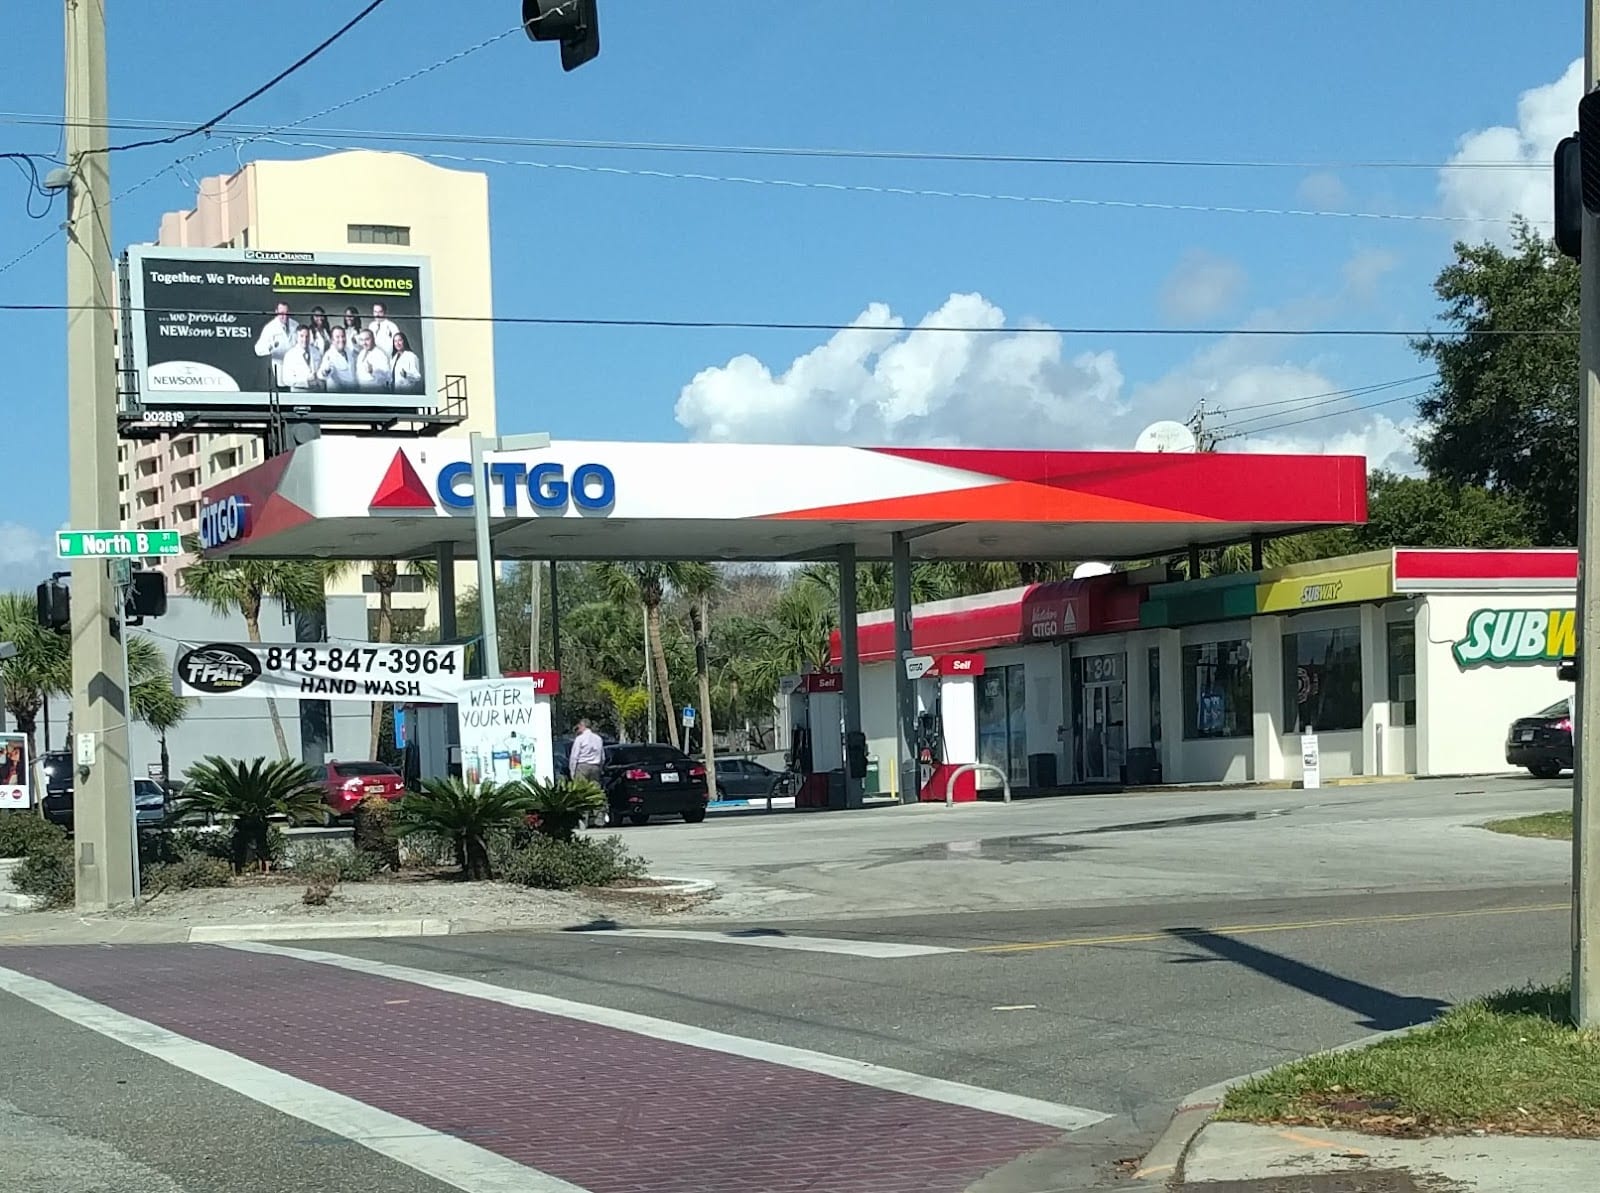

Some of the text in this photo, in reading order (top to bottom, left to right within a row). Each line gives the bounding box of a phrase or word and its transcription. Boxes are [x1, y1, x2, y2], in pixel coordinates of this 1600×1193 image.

[150, 271, 414, 290] Together, We Provide Amazing Outcomes
[188, 312, 237, 325] provide
[159, 325, 252, 338] NEWsom EYES!
[142, 411, 185, 423] 002819
[199, 495, 239, 549] CITGO
[60, 538, 71, 553] W
[82, 534, 132, 554] North
[136, 533, 150, 553] B
[1302, 582, 1343, 603] SUBWAY
[1032, 621, 1057, 638] CITGO
[266, 646, 457, 675] 813-847-3964
[953, 660, 972, 670] Self
[300, 677, 421, 697] HAND WASH
[819, 678, 836, 687] Self
[470, 687, 522, 707] WATER
[461, 707, 533, 728] YOUR WAY
